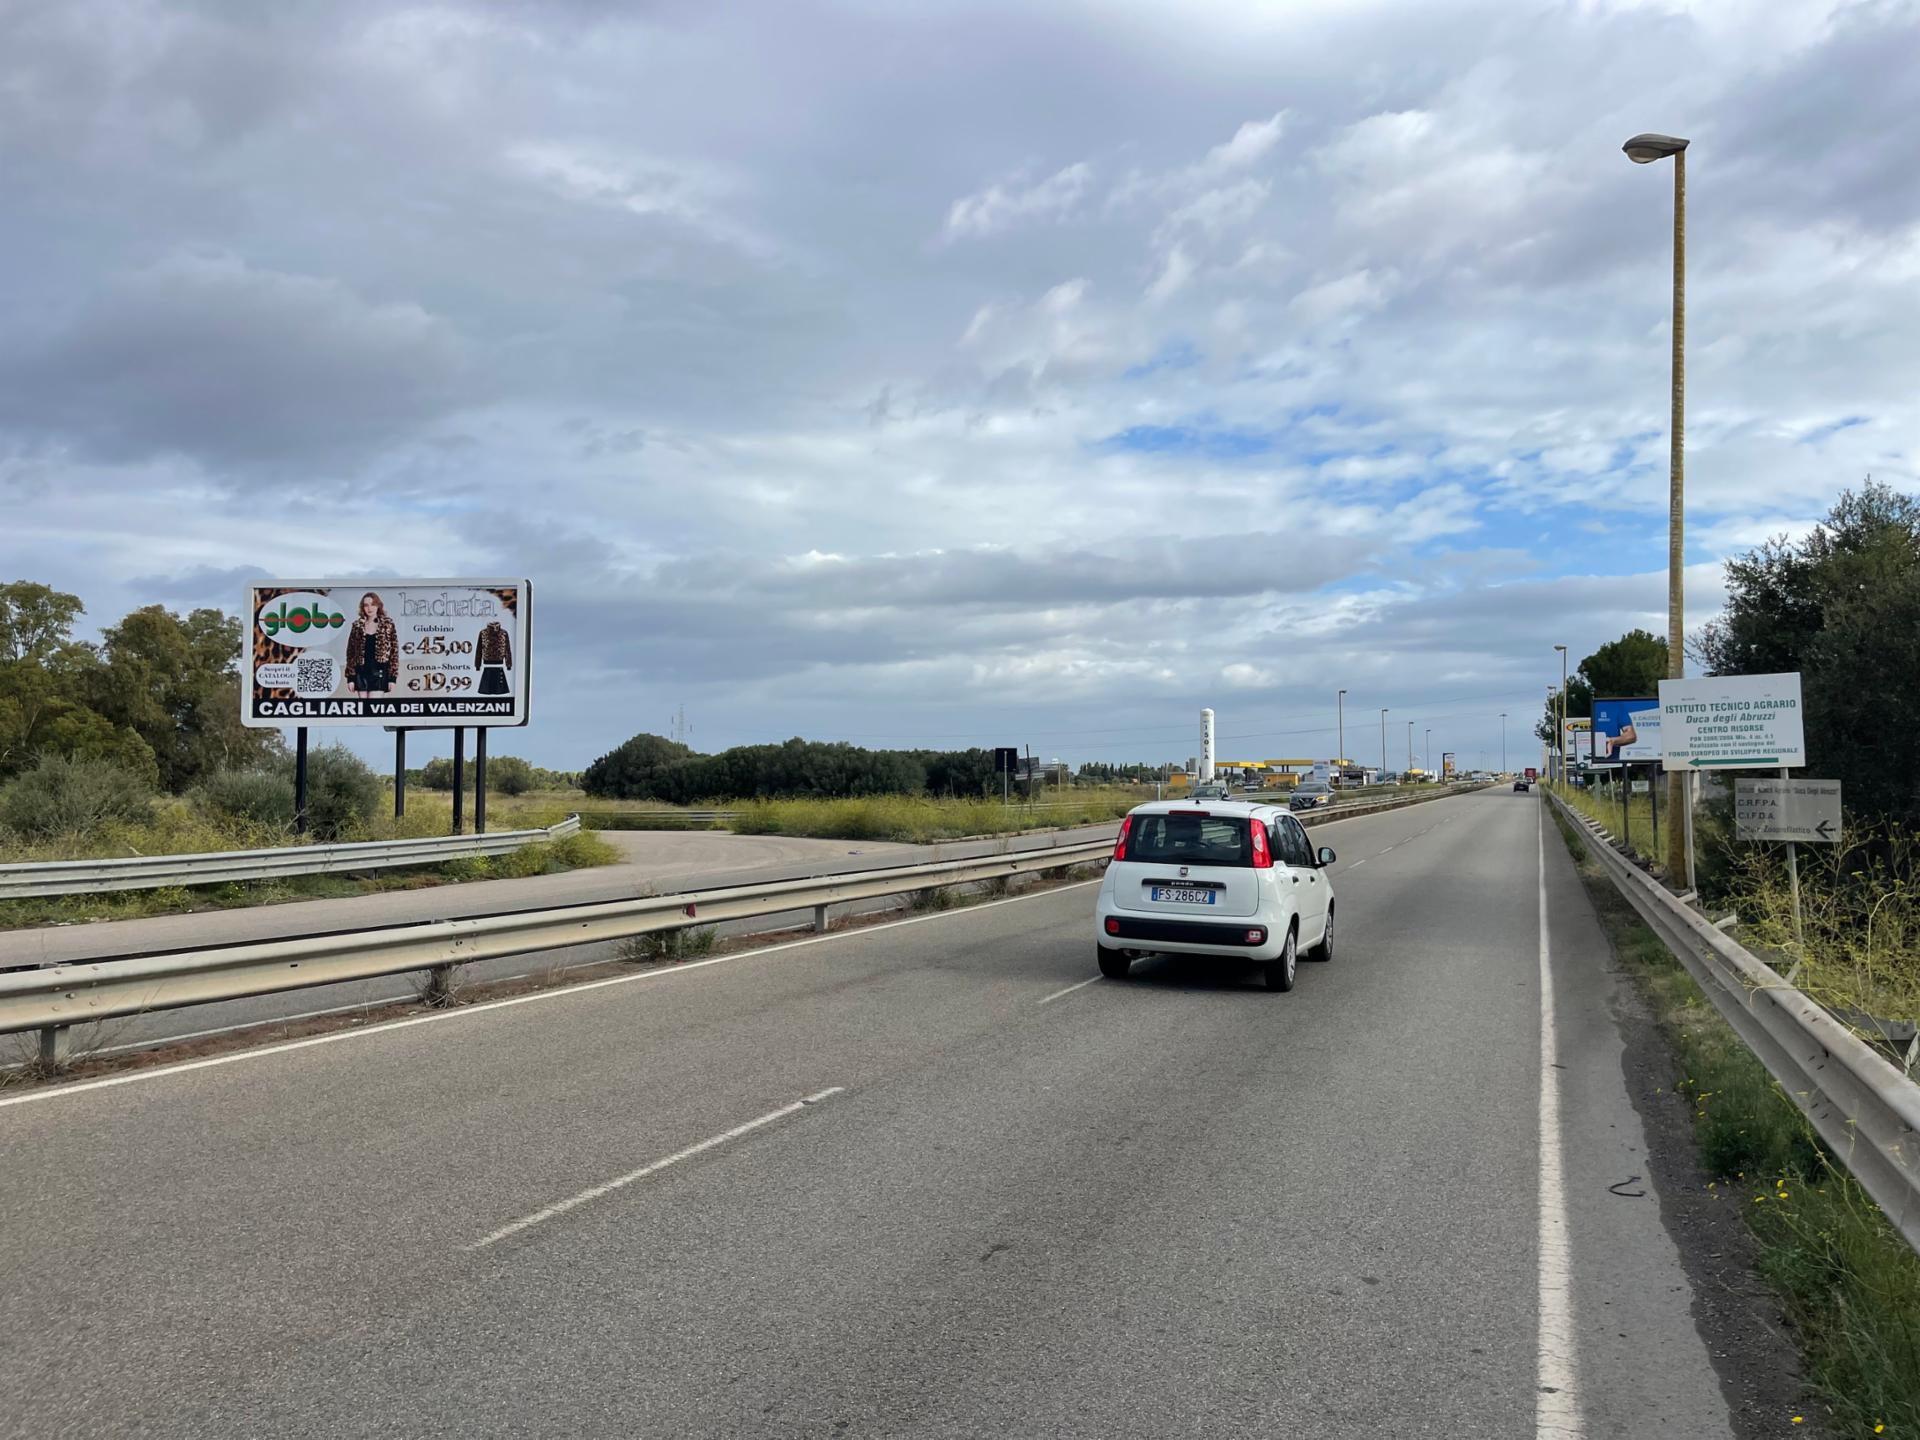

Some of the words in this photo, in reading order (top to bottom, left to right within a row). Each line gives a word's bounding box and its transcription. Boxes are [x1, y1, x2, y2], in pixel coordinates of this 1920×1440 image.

[398, 592, 496, 617] bachata
[263, 602, 345, 636] globo
[401, 636, 472, 656] €45,00
[407, 672, 472, 693] €19,99
[258, 701, 363, 716] CAGLIARI
[370, 704, 396, 714] VIA
[400, 704, 424, 713] DEI
[428, 702, 511, 713] VALENZANI
[1665, 704, 1706, 714] ISTITUTO
[1710, 701, 1750, 712] TECNICO
[1753, 699, 1796, 709] AGRARIO
[1686, 715, 1709, 724] Duca
[1713, 713, 1737, 724] degli
[1739, 712, 1776, 721] Abruzzi
[1697, 725, 1728, 734] CENTRO
[1730, 724, 1765, 732] RISORSE
